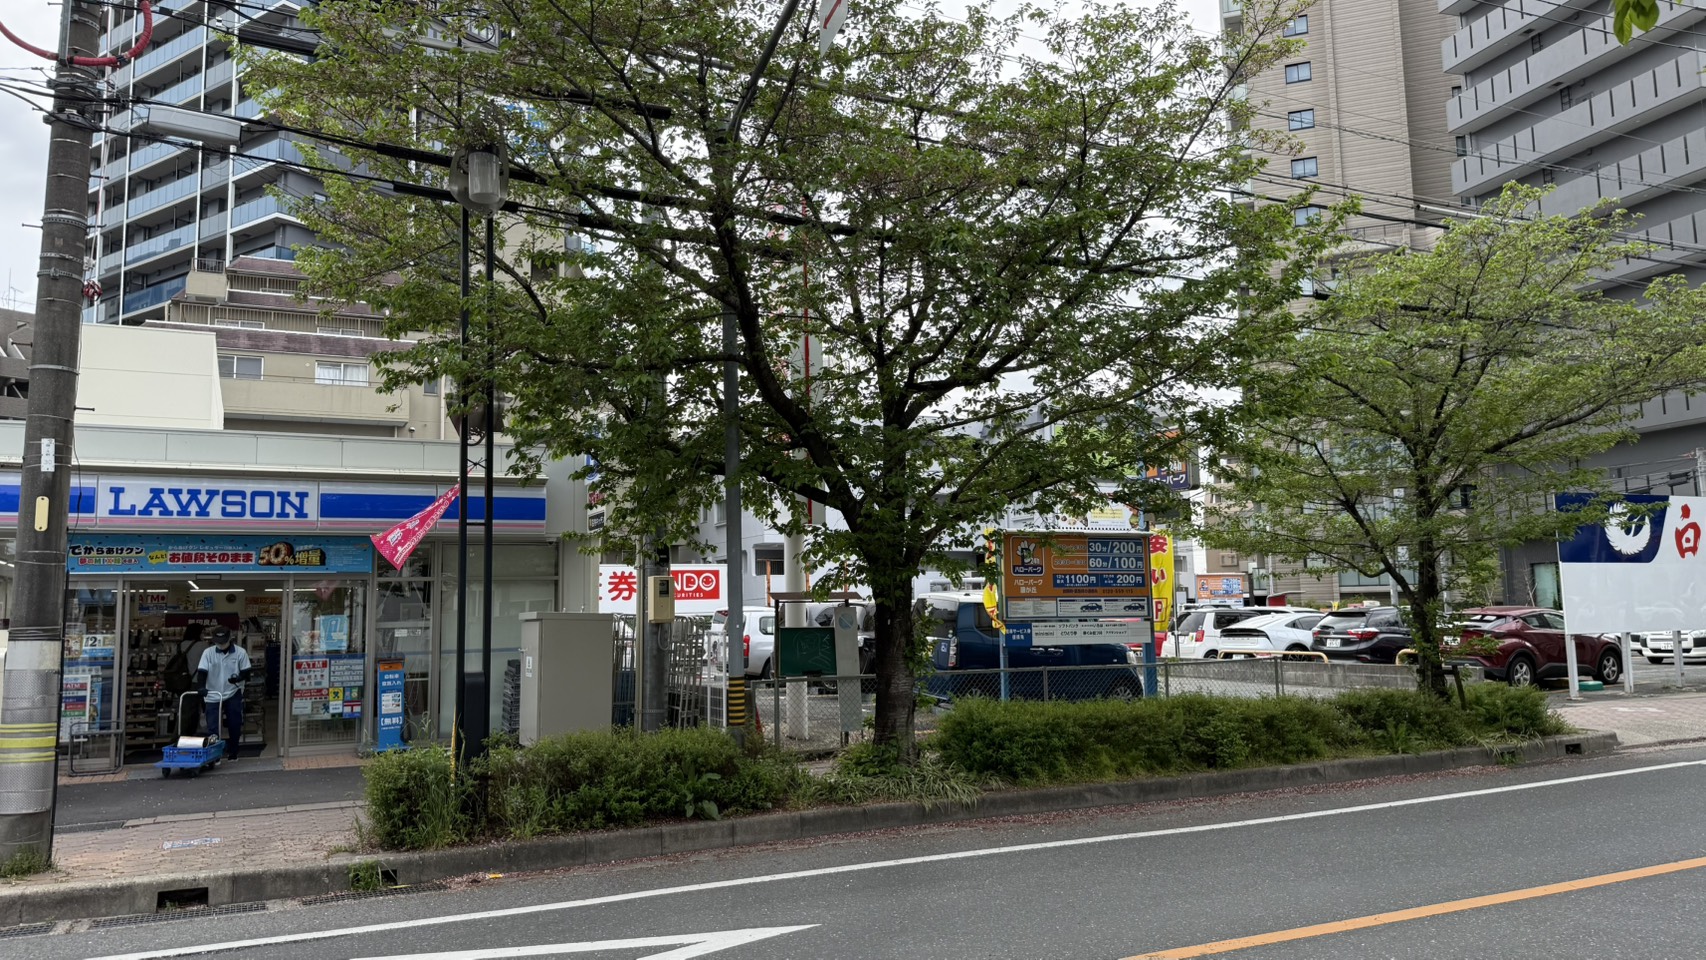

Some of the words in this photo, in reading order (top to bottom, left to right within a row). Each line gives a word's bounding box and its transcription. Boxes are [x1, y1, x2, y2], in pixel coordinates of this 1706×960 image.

[109, 487, 309, 518] LAWSON
[168, 552, 254, 564] お値段そのまま
[1089, 556, 1144, 569] 60分/100円
[671, 572, 717, 592] NDO
[1065, 574, 1097, 584] 1100円
[1116, 574, 1143, 584] 200円
[599, 570, 637, 601] 券
[301, 661, 323, 670] ATM
